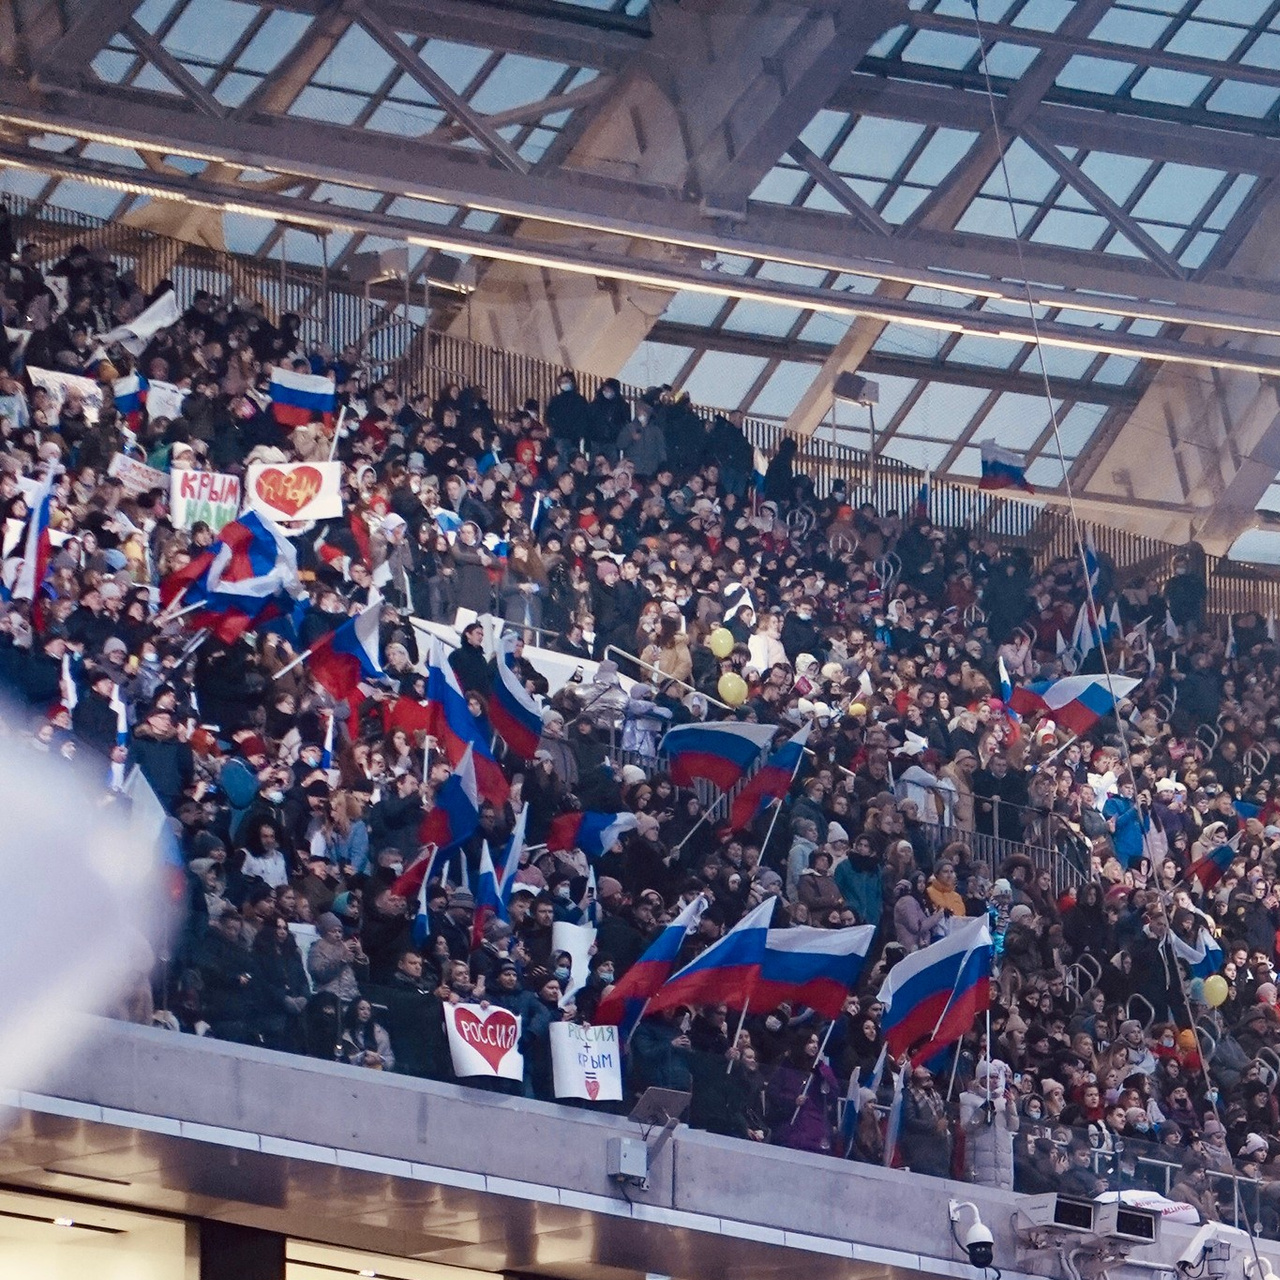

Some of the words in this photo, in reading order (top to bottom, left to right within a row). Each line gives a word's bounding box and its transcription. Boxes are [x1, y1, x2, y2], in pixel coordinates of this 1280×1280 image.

[181, 472, 239, 504] КРЫМ
[460, 1020, 517, 1049] РОССИЯ
[578, 1053, 612, 1069] КРЫМ
